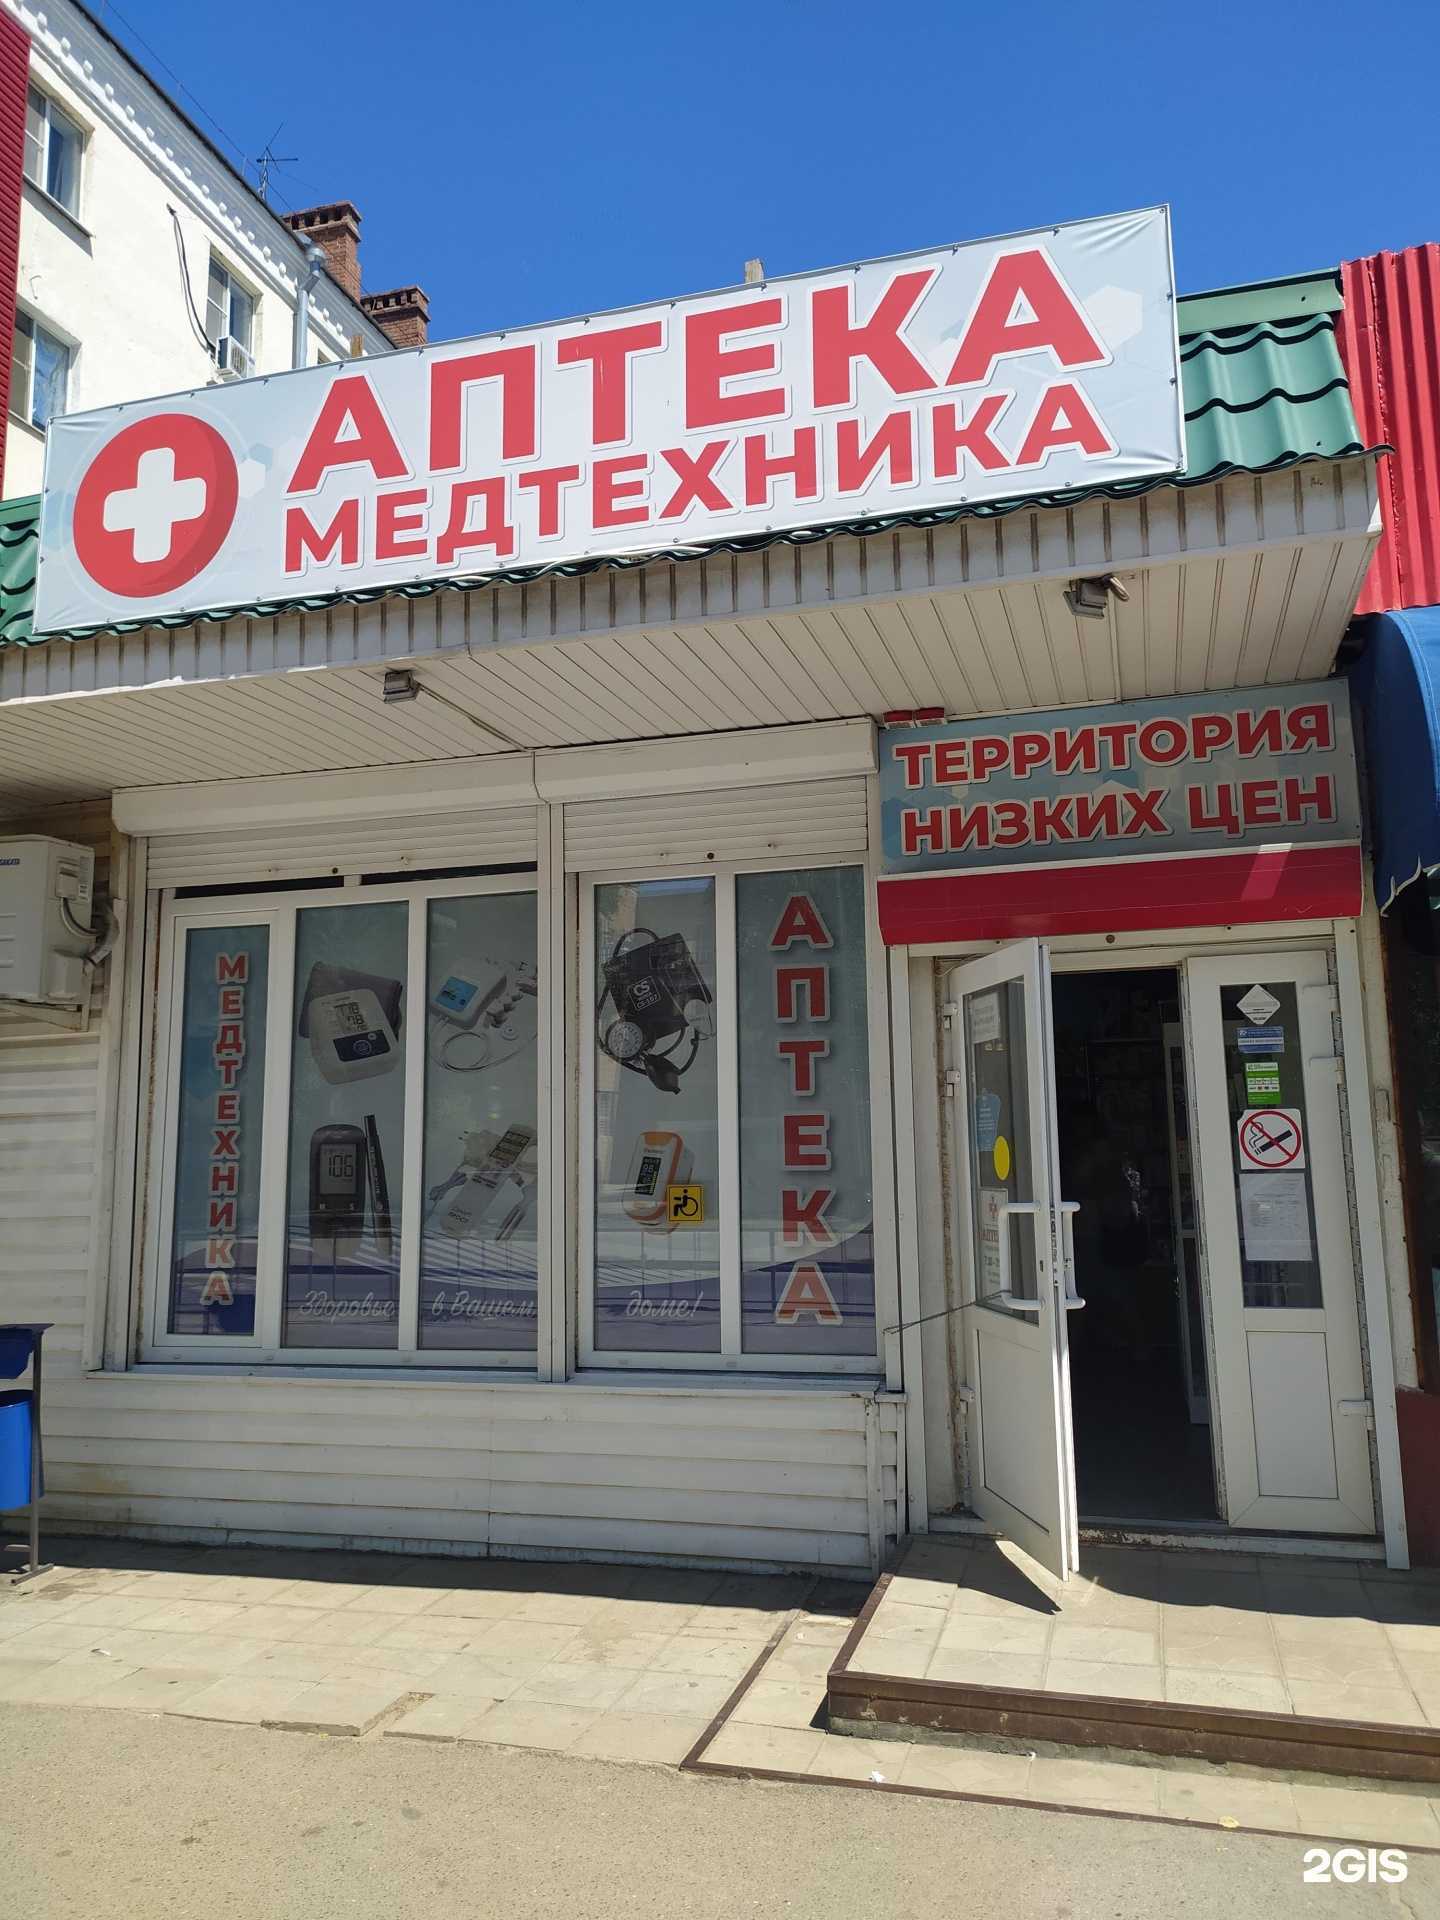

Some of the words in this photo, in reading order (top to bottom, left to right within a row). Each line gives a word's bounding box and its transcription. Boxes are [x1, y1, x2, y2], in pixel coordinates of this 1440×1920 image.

[288, 251, 1102, 493] АПТЕКА
[285, 383, 1113, 573] МЕДТЕХНИКА
[894, 704, 1331, 786] ТЕРРИТОРИЯ
[904, 790, 1163, 853] НИЗКИХ
[1187, 775, 1334, 833] ЦЕН
[203, 955, 247, 1304] МЕДТЕХНИКА
[772, 894, 842, 1322] АПТЕКА
[300, 1290, 396, 1323] Здоровье
[432, 1290, 446, 1316] в
[450, 1290, 538, 1319] Вашем
[625, 1290, 704, 1320] доме!
